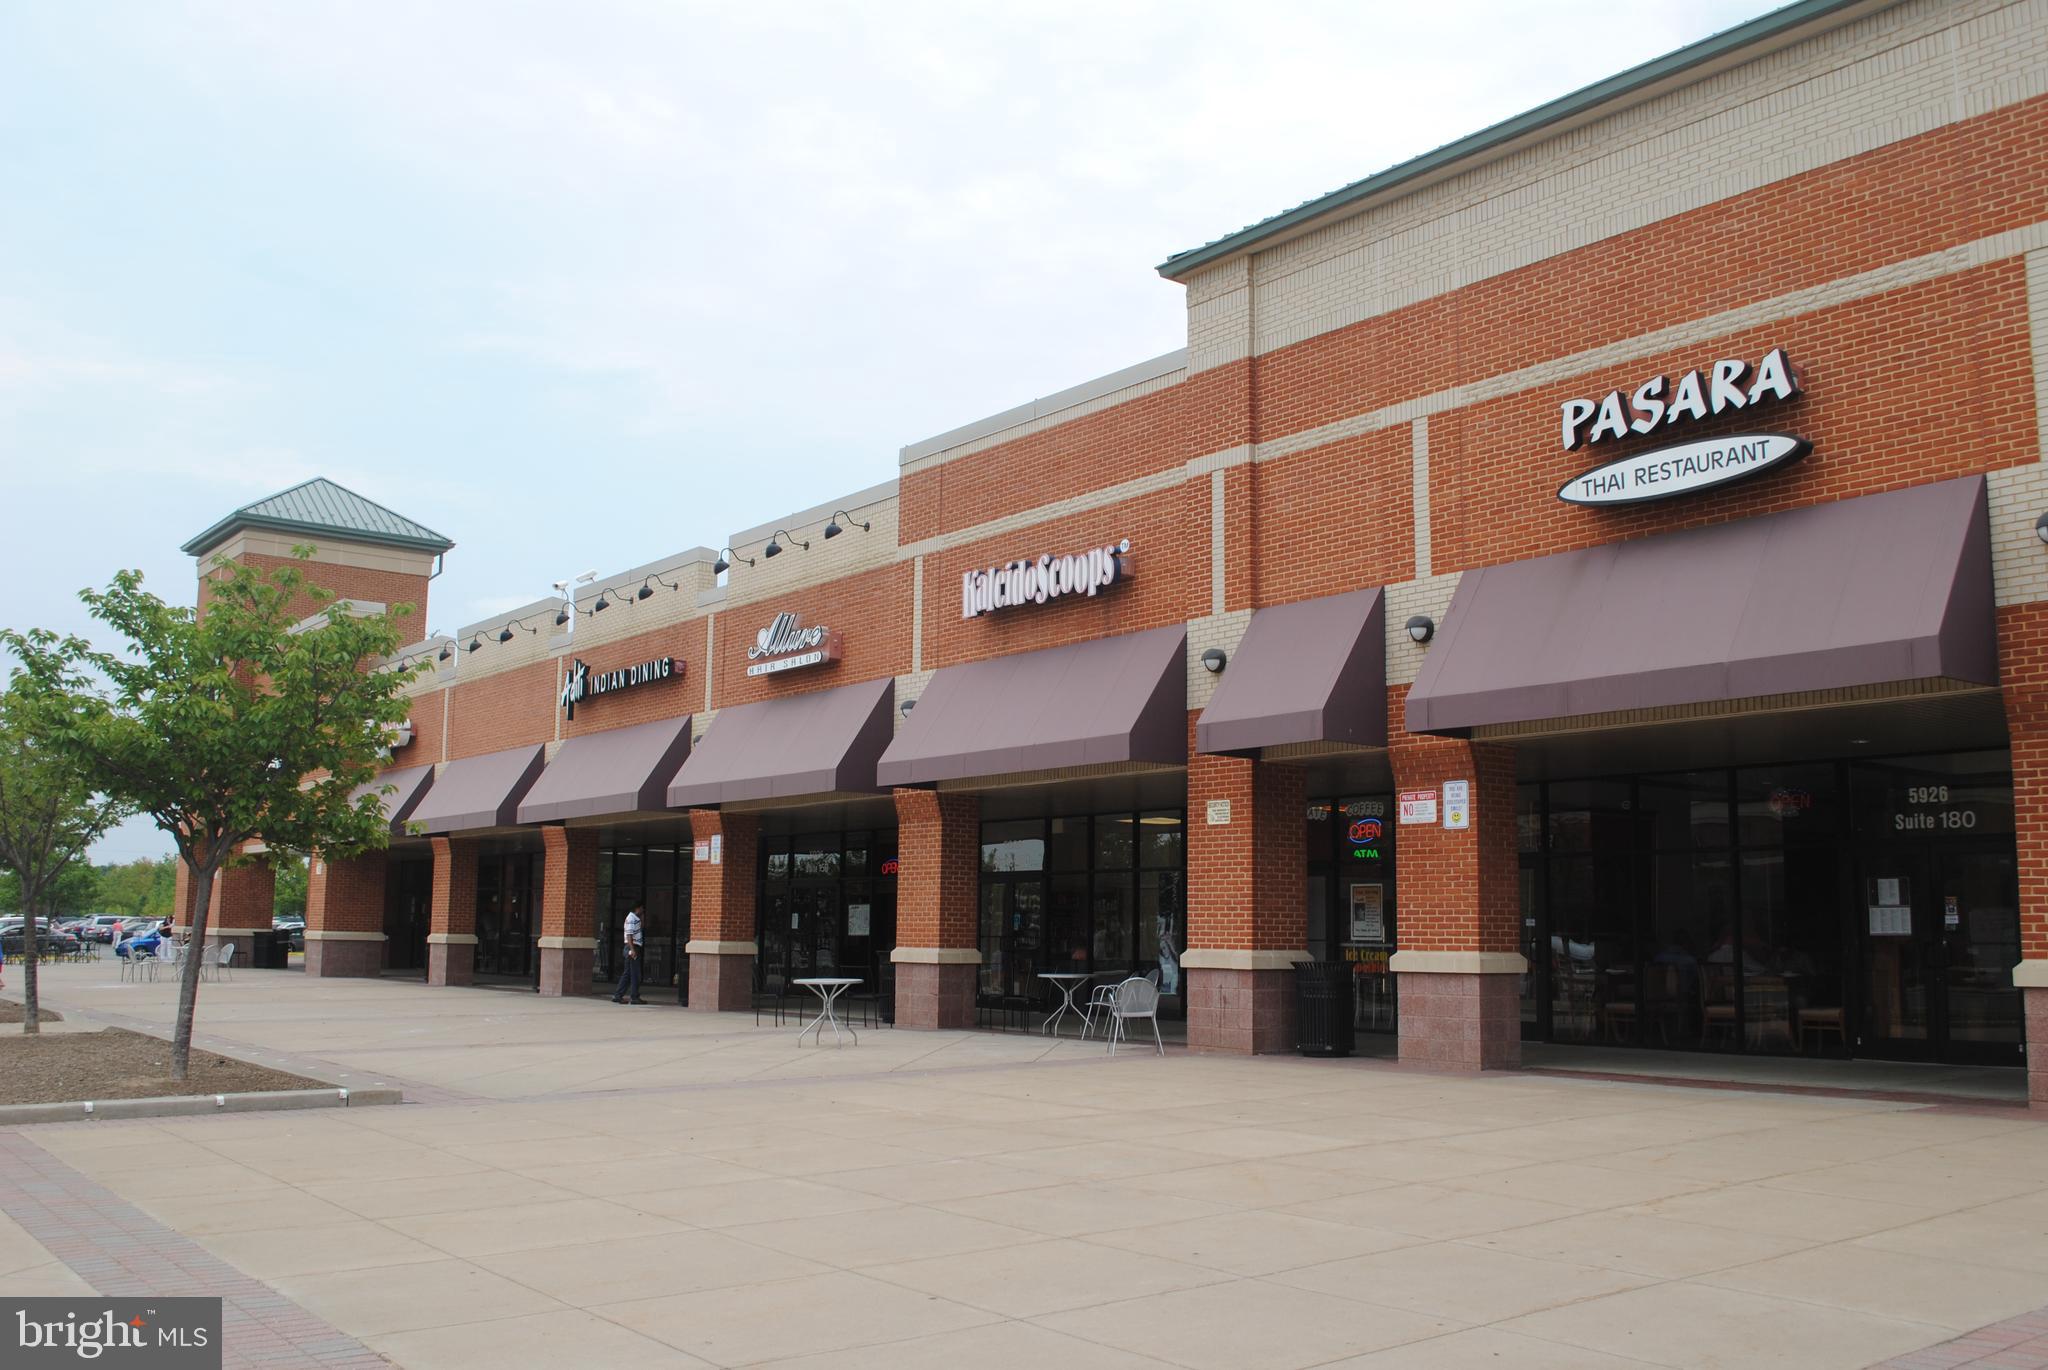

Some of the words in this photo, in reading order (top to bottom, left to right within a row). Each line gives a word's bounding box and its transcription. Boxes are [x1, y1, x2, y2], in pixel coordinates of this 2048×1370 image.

[1561, 348, 1793, 450] PASARA
[1582, 472, 1625, 497] THAI
[1635, 440, 1770, 486] RESTAURANT
[749, 663, 776, 675] HAIR
[784, 652, 821, 668] SALON
[590, 670, 625, 695] INDIAN
[631, 657, 669, 685] DINING
[1909, 786, 1949, 803] 5926
[1346, 801, 1384, 817] COFFEE
[1404, 803, 1414, 816] NO
[1895, 814, 1935, 830] Suite
[1940, 810, 1977, 828] 180
[1350, 823, 1381, 838] OPEN
[1354, 849, 1379, 858] ATM
